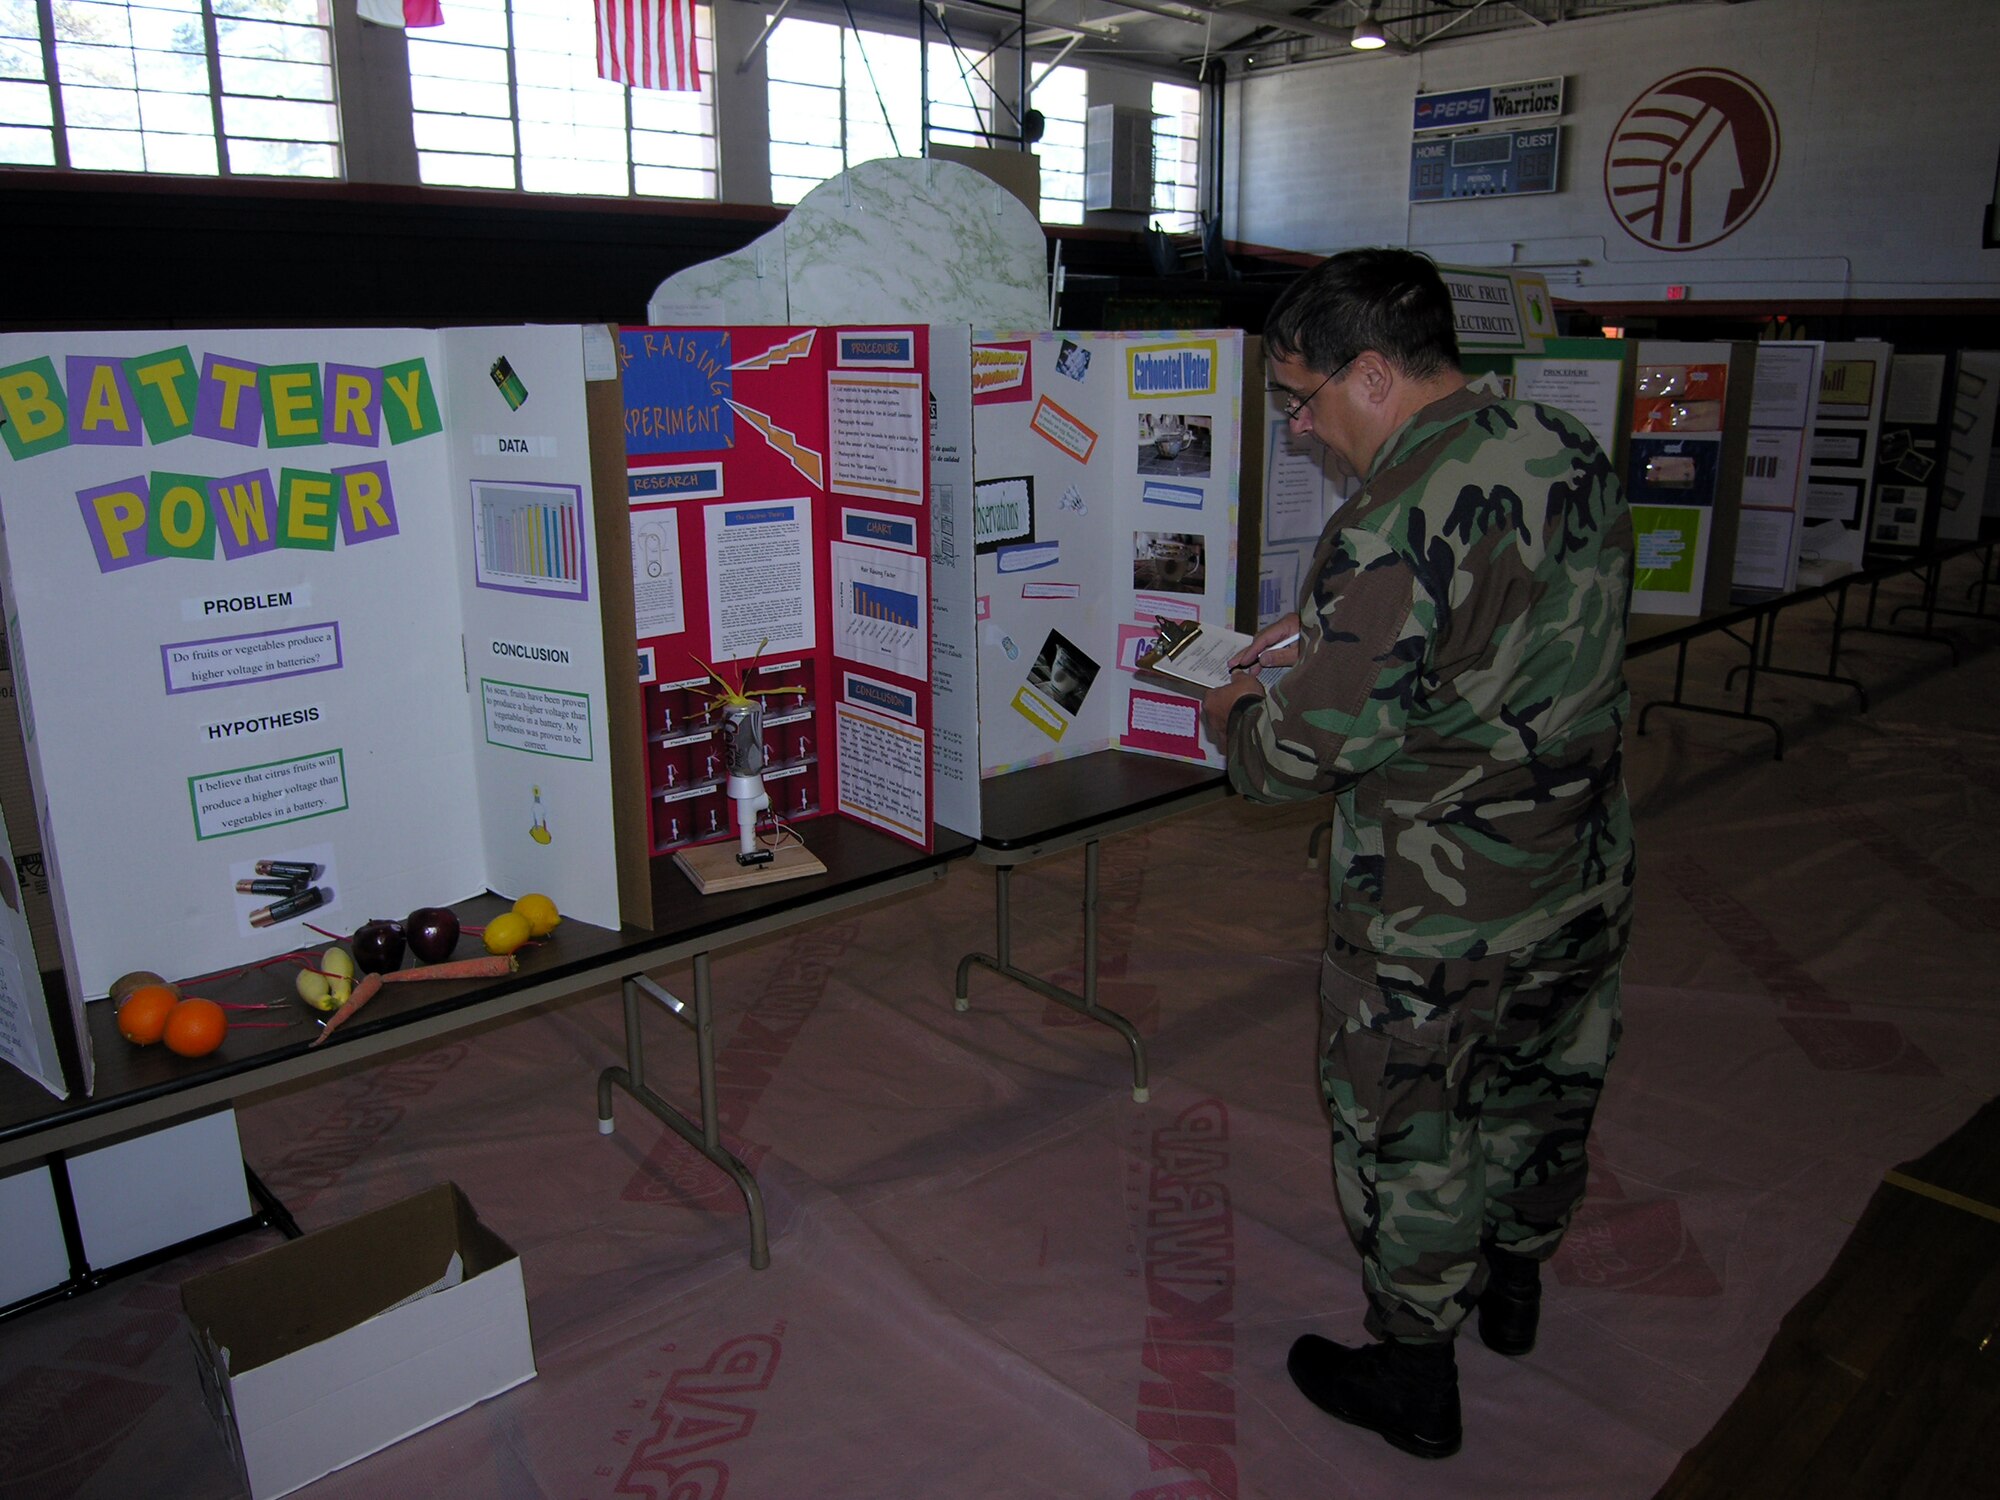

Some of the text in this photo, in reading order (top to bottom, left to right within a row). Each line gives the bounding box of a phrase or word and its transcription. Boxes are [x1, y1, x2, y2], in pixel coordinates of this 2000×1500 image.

[1433, 98, 1485, 118] PEPSI
[1492, 92, 1559, 116] Warriors
[1416, 145, 1446, 158] HOME
[1516, 134, 1554, 148] GUEST
[1479, 286, 1508, 301] FRUIT
[1454, 314, 1514, 332] LECTRICITY
[850, 342, 900, 355] PROCEDURE
[643, 334, 730, 396] RAISING
[1134, 352, 1209, 391] Carbonated Water
[0, 359, 423, 445] BATTERY
[624, 404, 720, 439] XPERIMENT
[498, 439, 528, 454] DATA
[634, 474, 698, 491] RESEARCH
[93, 471, 391, 560] POWER
[974, 490, 1019, 535] bservations
[866, 522, 892, 536] CHART
[203, 592, 294, 616] PROBLEM
[173, 653, 190, 663] Do
[192, 650, 220, 661] fruits
[222, 648, 232, 656] or
[236, 642, 285, 656] vegetables
[287, 636, 324, 649] produce
[492, 641, 570, 665] CONCLUSION
[192, 654, 321, 682] higher voltage in batteries?
[510, 689, 526, 699] fruits
[528, 692, 543, 702] have
[544, 694, 561, 704] been
[562, 698, 586, 708] proven
[855, 684, 905, 708] CONCLUSION
[494, 699, 517, 710] produce
[523, 703, 543, 714] higher
[544, 707, 569, 720] voltage
[571, 711, 586, 720] than
[208, 707, 320, 740] HYPOTHESIS
[494, 712, 525, 723] vegetables
[526, 716, 533, 724] in
[540, 718, 565, 731] battery.
[566, 722, 578, 734] My
[494, 720, 525, 734] hypothesis
[540, 732, 563, 742] proven
[572, 736, 582, 744] be
[199, 756, 336, 793] I believe that citrus fruits will
[202, 798, 242, 814] produce
[252, 789, 283, 802] higher
[284, 782, 318, 794] voltage
[320, 776, 339, 786] than
[221, 810, 272, 828] vegetables
[274, 808, 284, 817] in
[294, 798, 327, 813] battery.
